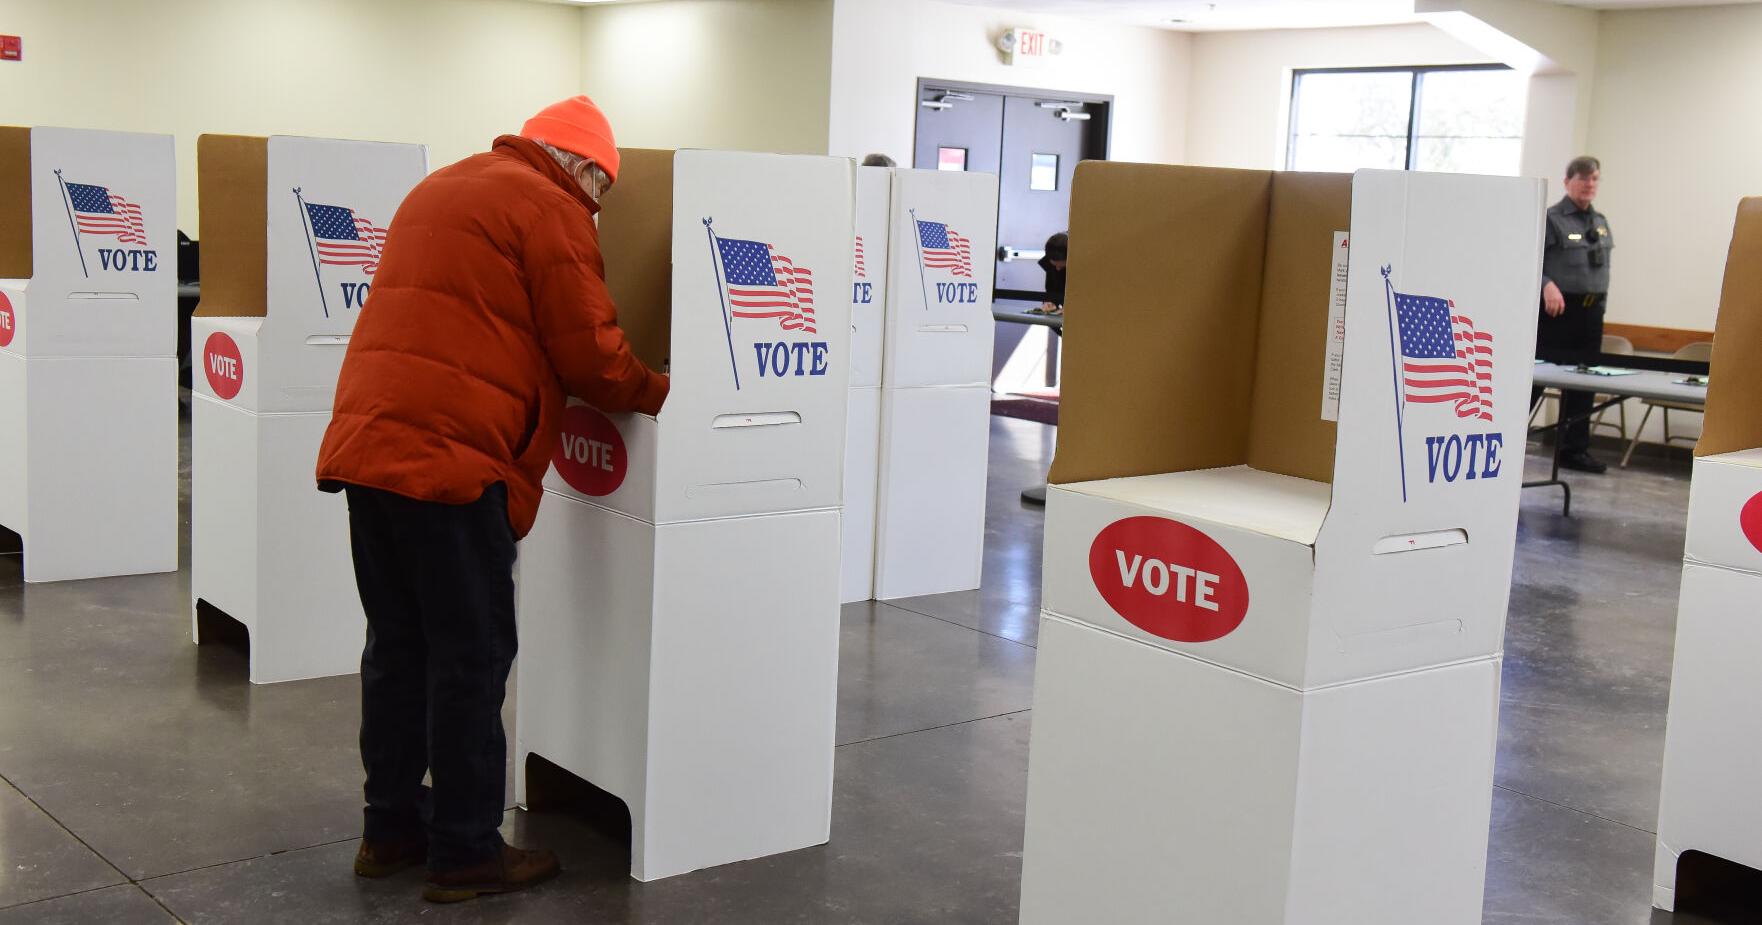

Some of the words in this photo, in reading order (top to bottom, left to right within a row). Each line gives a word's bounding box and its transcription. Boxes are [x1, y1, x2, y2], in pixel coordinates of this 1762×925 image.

[1021, 31, 1044, 56] EXIT
[98, 248, 158, 272] VOTE
[340, 282, 371, 309] VO
[853, 282, 872, 304] TE
[936, 282, 978, 304] VOTE
[0, 310, 11, 330] TE
[209, 352, 237, 380] VOTE
[753, 341, 829, 378] VOTE
[561, 431, 614, 472] VOTE
[1425, 432, 1503, 484] VOTE
[1115, 549, 1220, 612] VOTE
